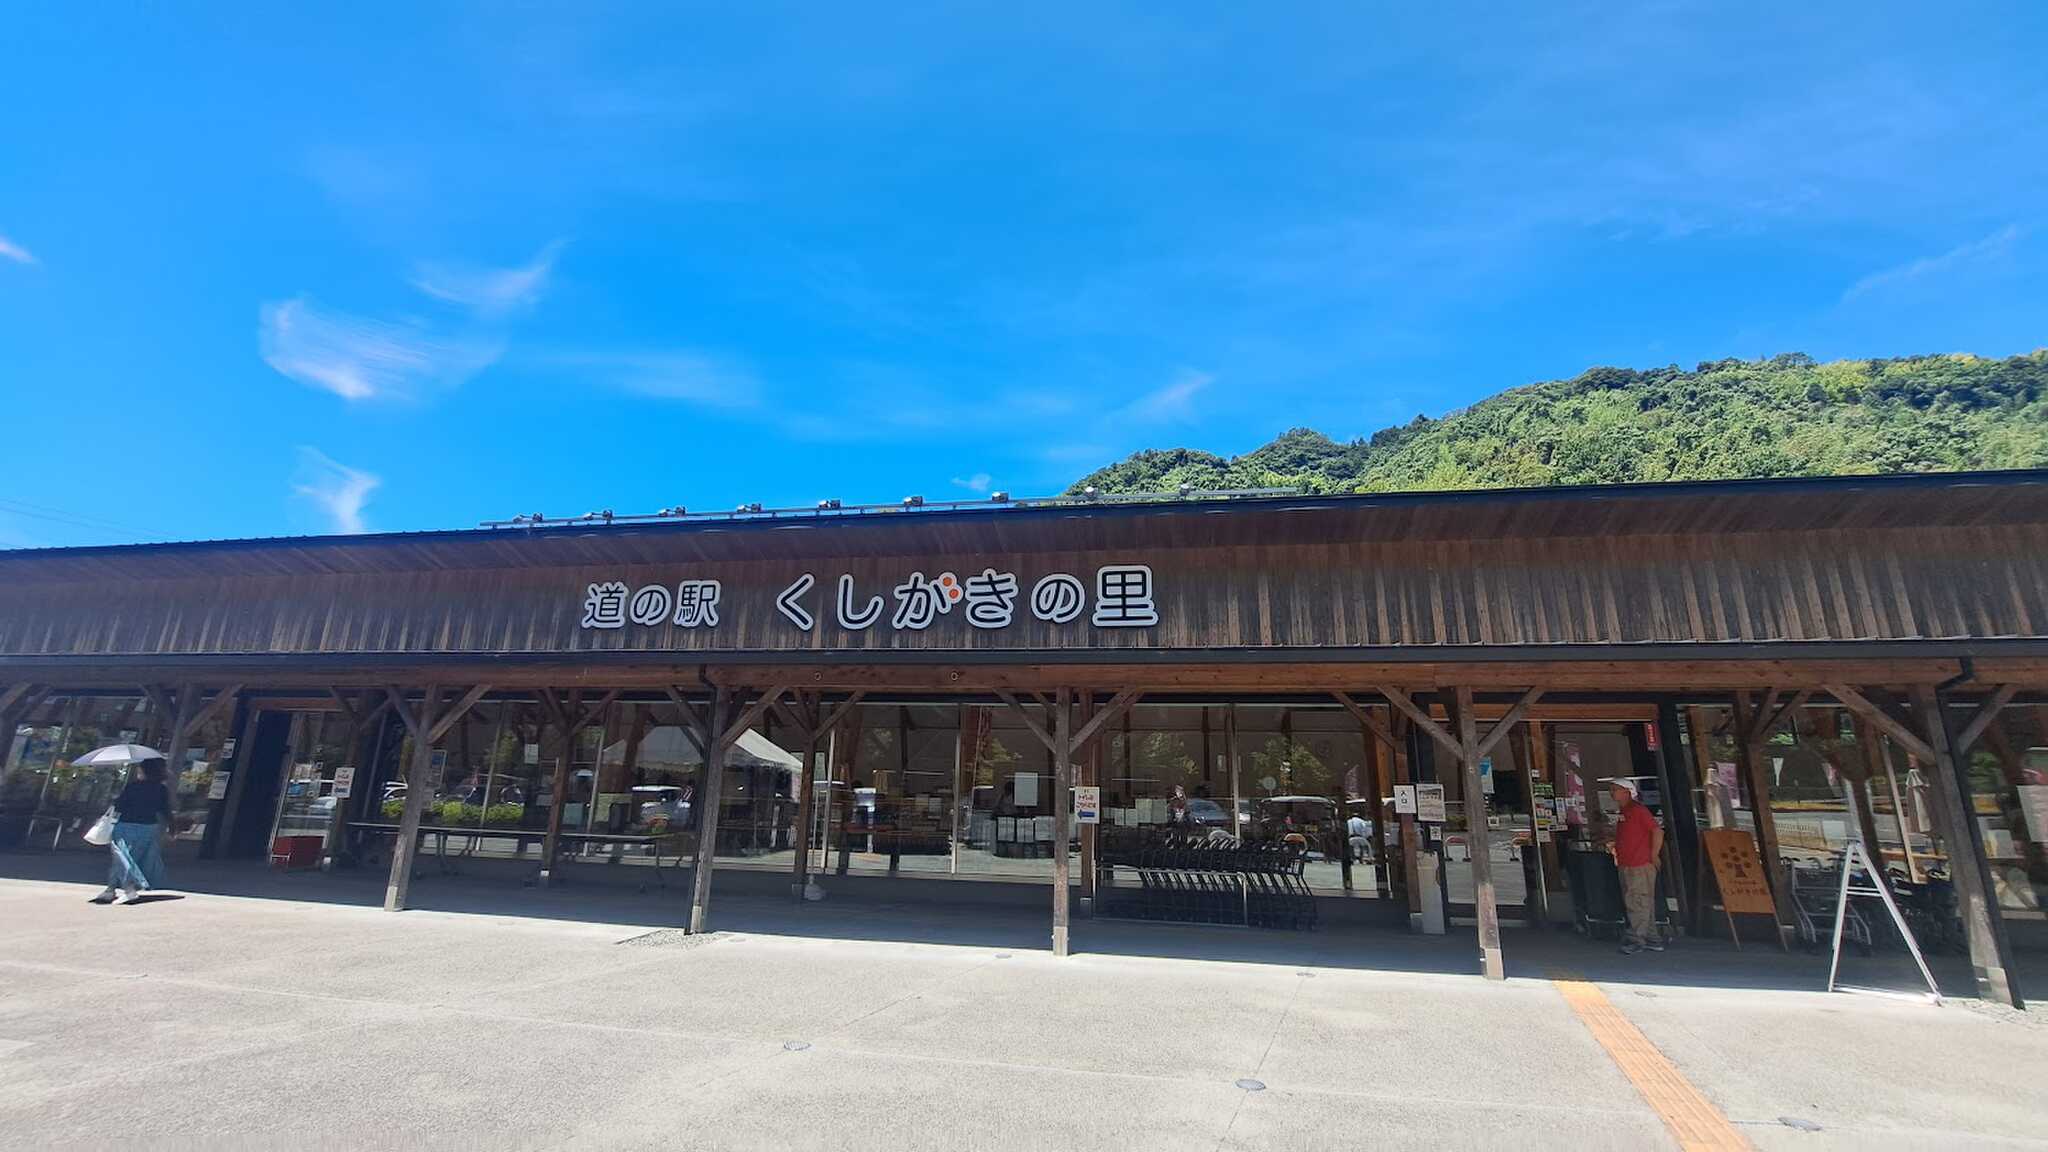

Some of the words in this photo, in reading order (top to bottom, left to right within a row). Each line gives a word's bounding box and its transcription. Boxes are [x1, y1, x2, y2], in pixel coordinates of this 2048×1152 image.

[582, 580, 721, 629] 道の駅
[776, 565, 1159, 631] くしがきの里
